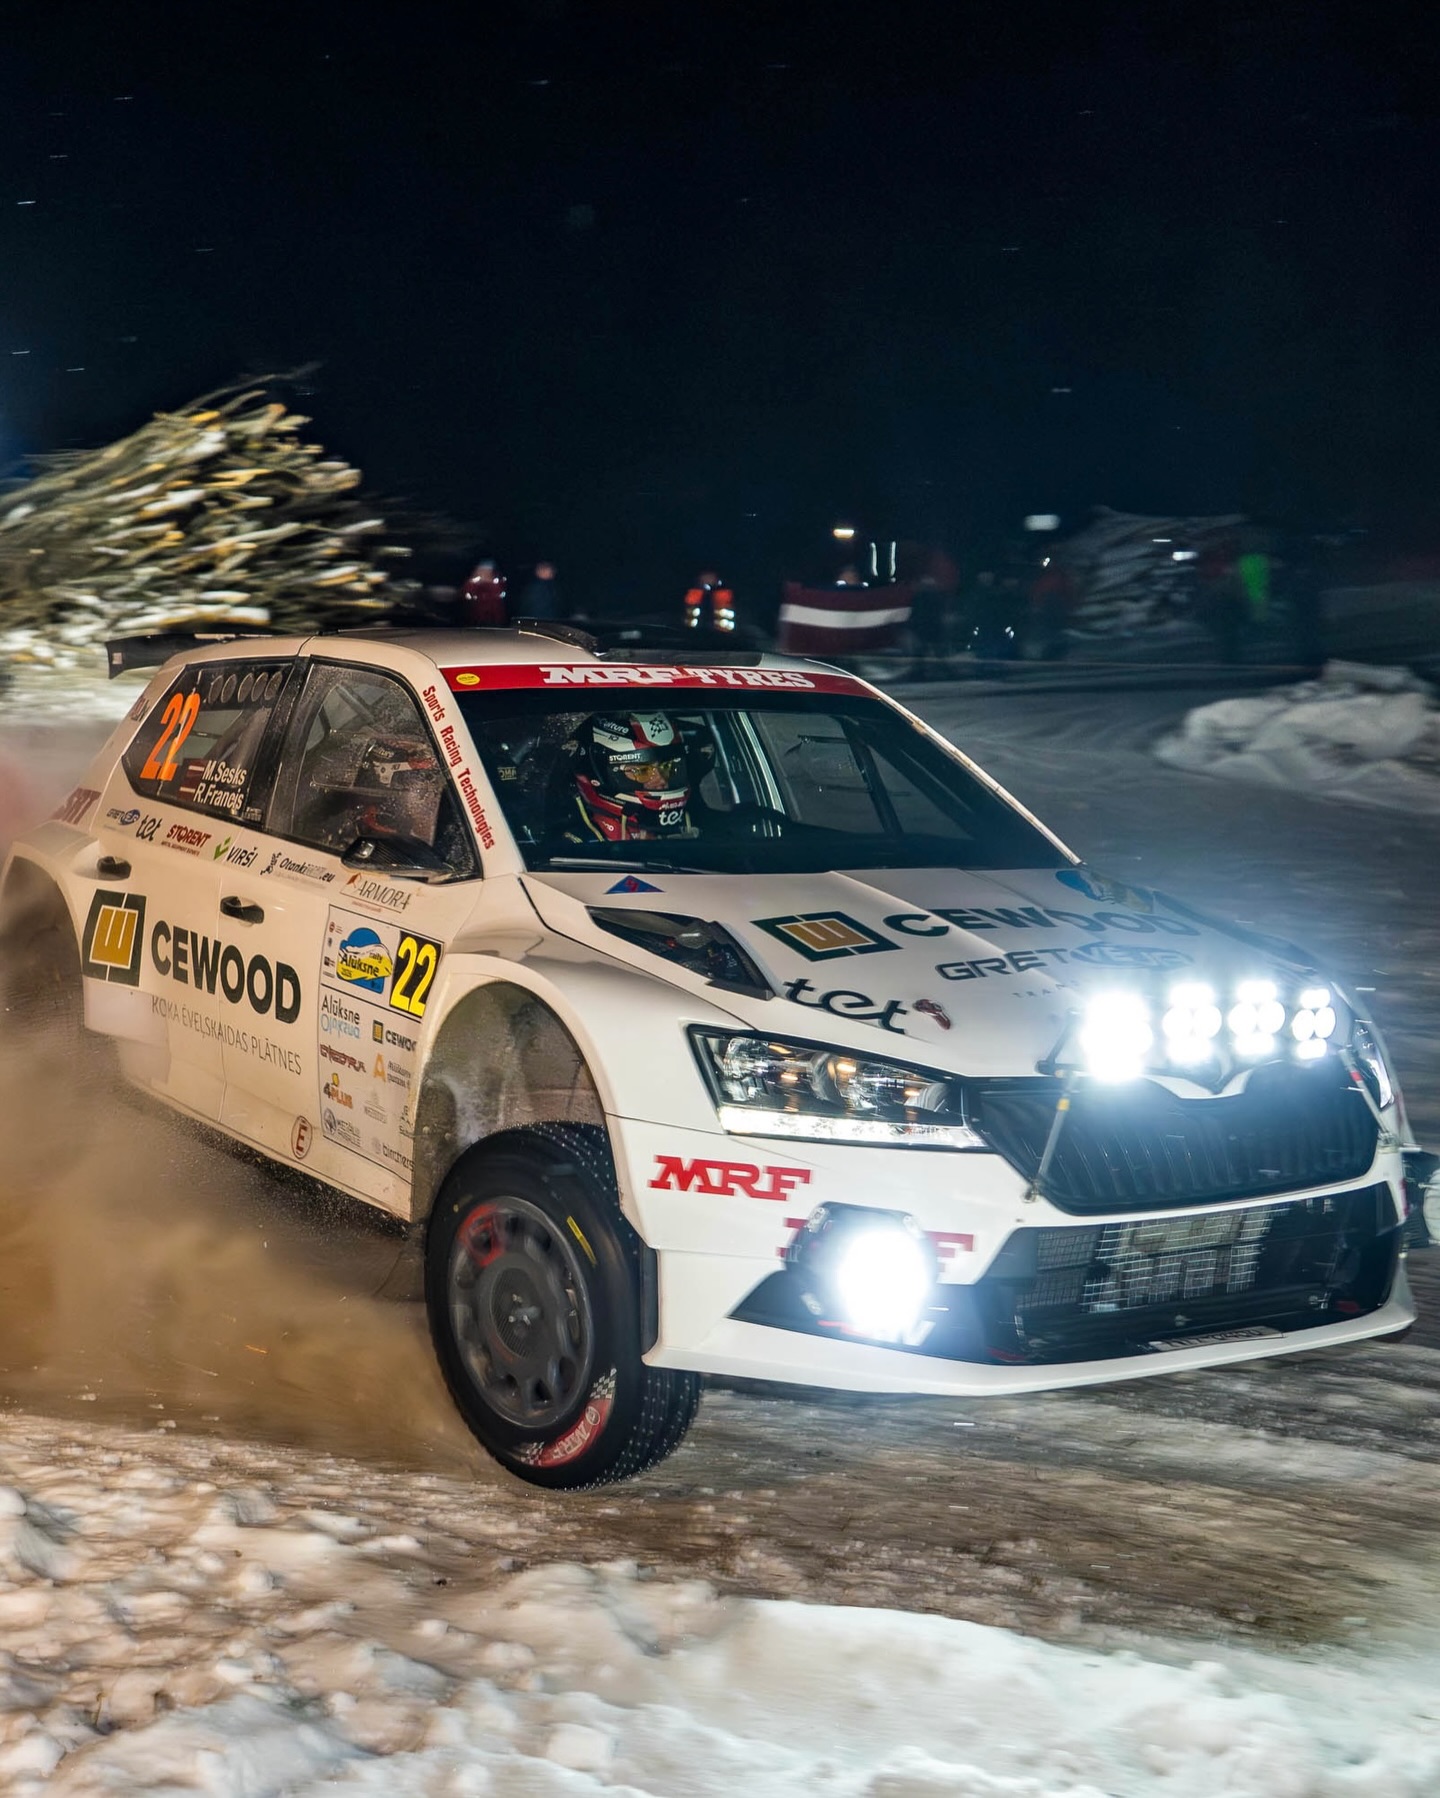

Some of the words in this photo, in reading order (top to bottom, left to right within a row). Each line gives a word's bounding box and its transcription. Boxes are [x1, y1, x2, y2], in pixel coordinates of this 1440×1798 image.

[539, 667, 682, 684] MRF
[690, 669, 816, 688] TYRES
[140, 693, 200, 781] 22
[202, 759, 247, 785] M.Sesks
[422, 685, 445, 722] Sports
[440, 725, 463, 768] Racing
[457, 768, 495, 850] Technologies
[135, 814, 163, 841] tet
[166, 824, 212, 848] STORENT
[226, 846, 259, 868] VIRŠI
[356, 880, 411, 910] ARMORA
[883, 906, 1202, 937] CEWOOD
[151, 920, 302, 1024] CEWOOD
[340, 953, 380, 978] Alūksne
[390, 936, 437, 1018] 22
[321, 994, 360, 1025] Alūksne
[783, 978, 912, 1035] tet
[152, 995, 180, 1020] KOKA
[251, 1036, 302, 1075] PLĀTNES
[647, 1155, 813, 1201] MRF
